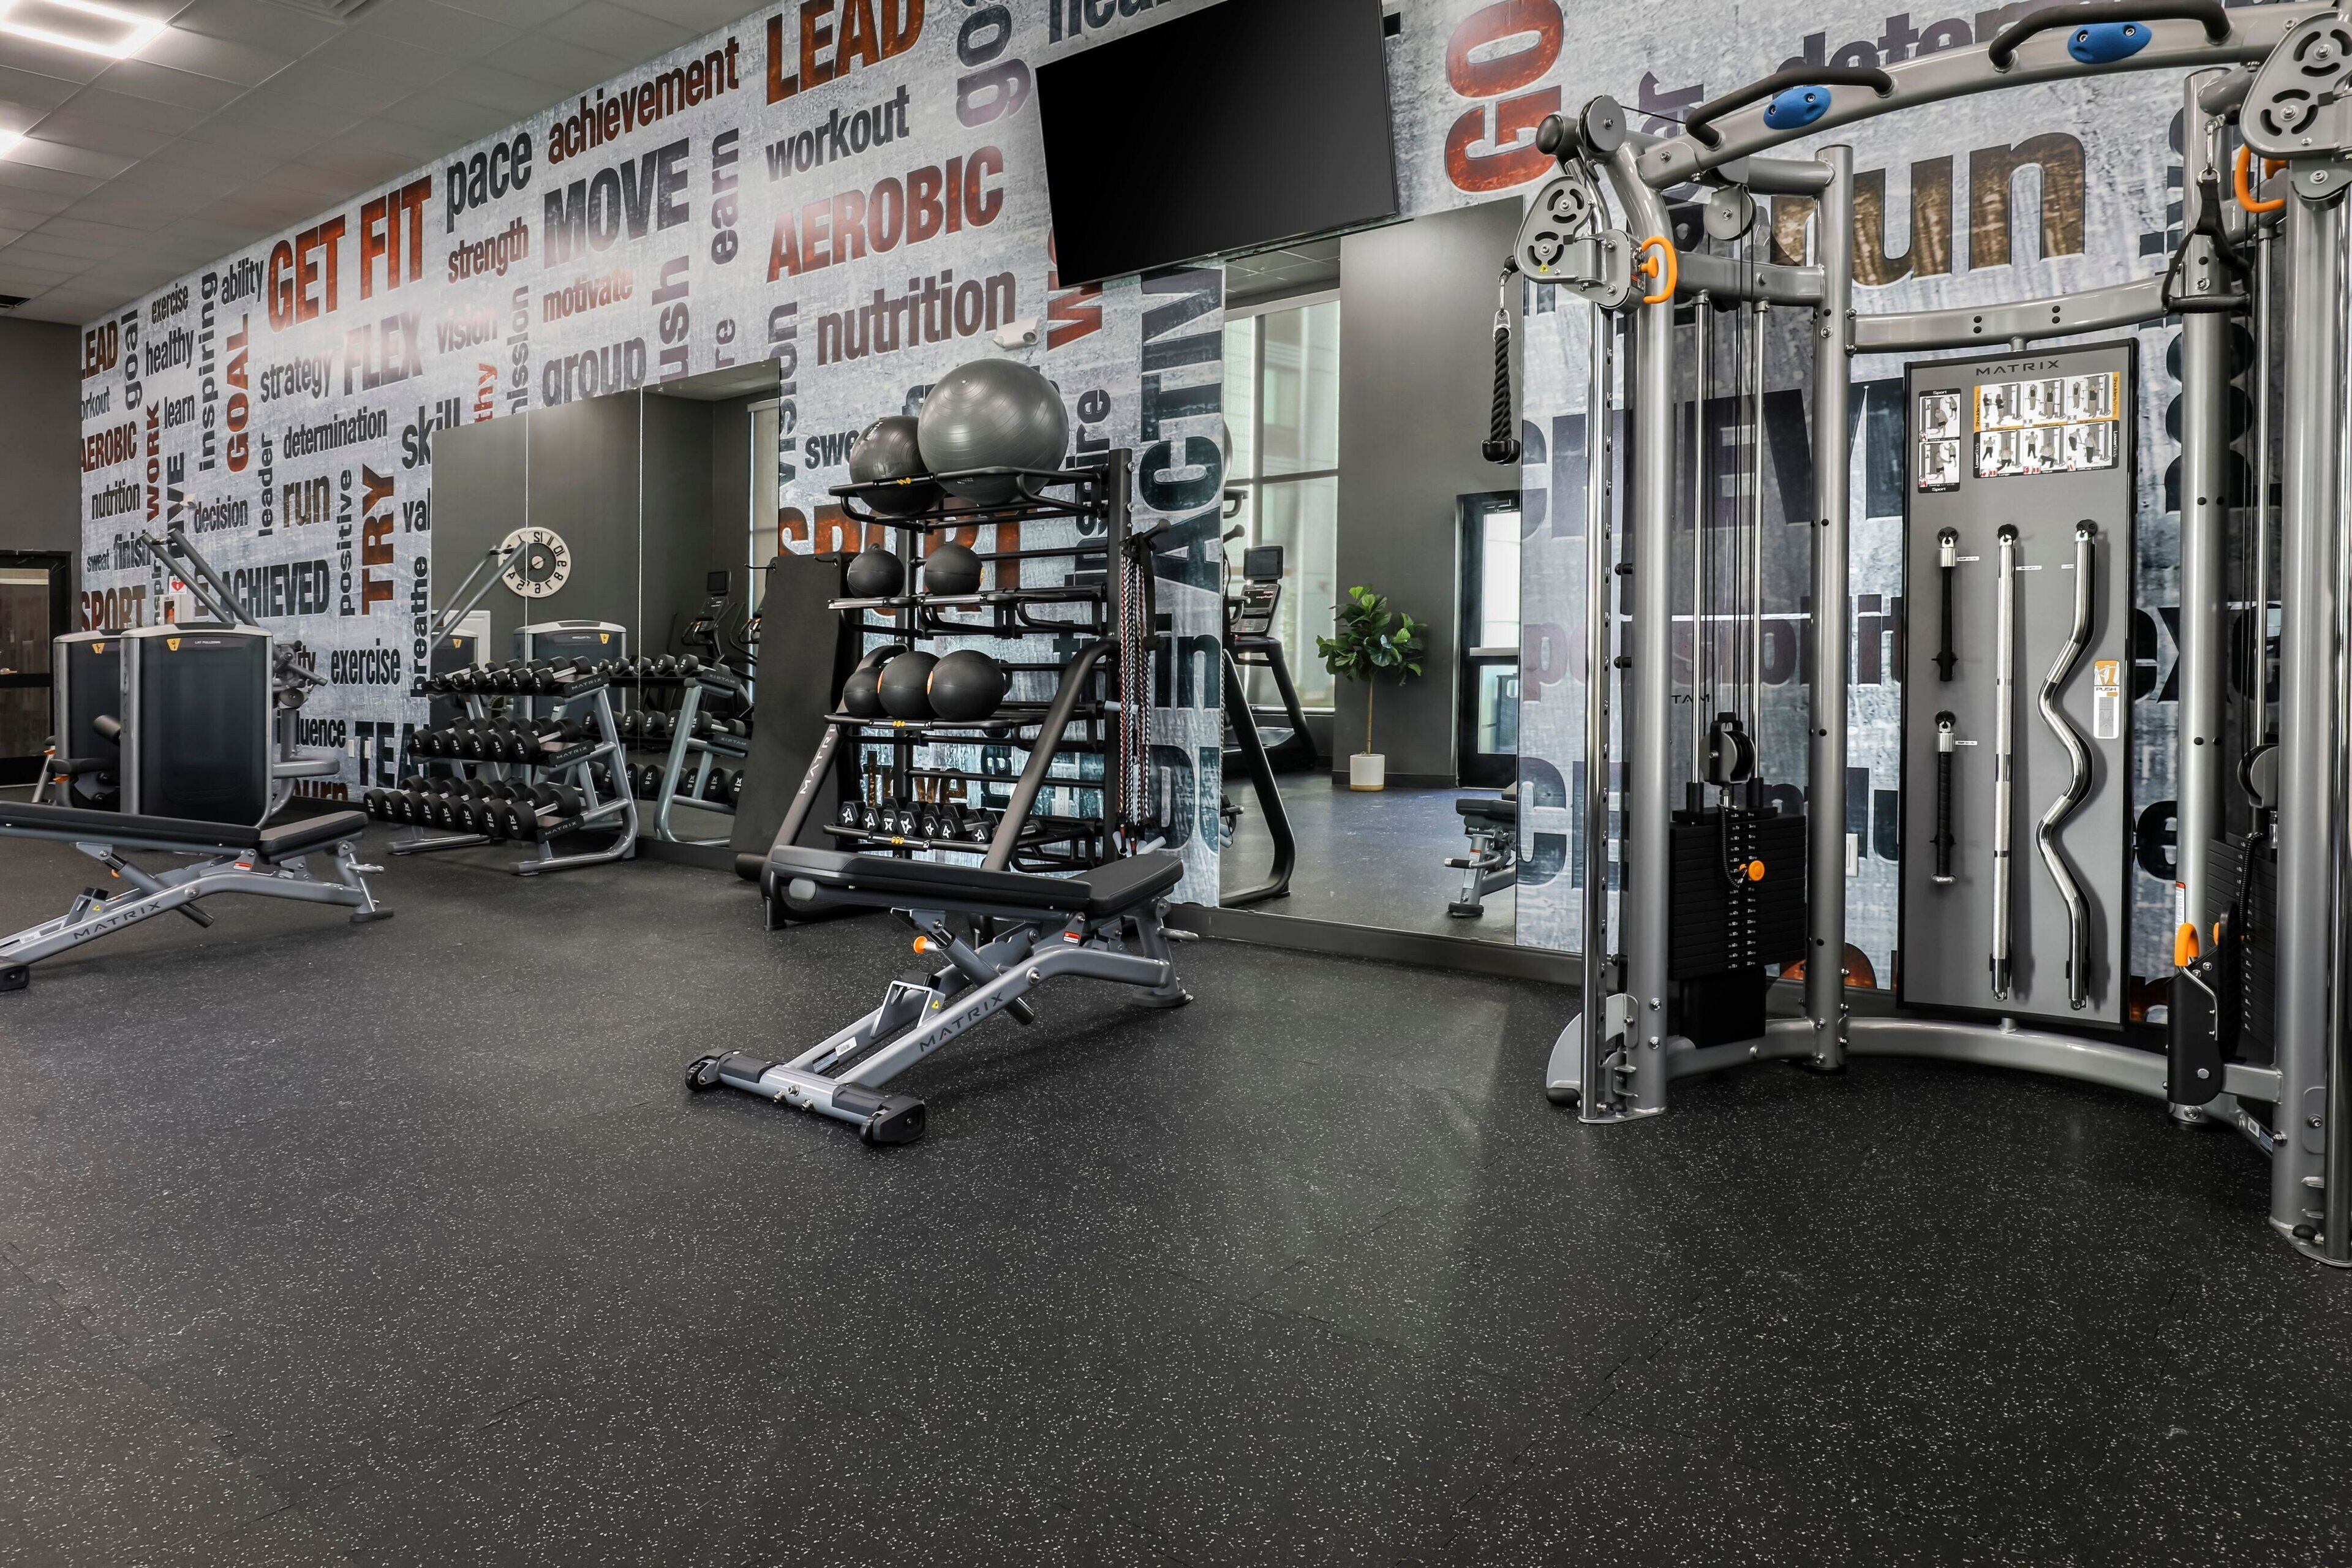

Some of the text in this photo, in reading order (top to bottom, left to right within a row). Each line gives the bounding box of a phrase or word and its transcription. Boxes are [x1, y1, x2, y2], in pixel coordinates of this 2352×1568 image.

[766, 0, 924, 106] LEAD
[549, 36, 739, 164] achievement
[766, 85, 910, 182] workout
[447, 132, 532, 234] pace
[544, 137, 689, 268] MOVE
[711, 128, 739, 265] earn
[766, 146, 1003, 283] AEROBIC
[222, 257, 264, 304] ability
[268, 175, 431, 333] GET FIT
[448, 217, 529, 284] strength
[152, 283, 189, 324] exercise
[543, 268, 633, 323] motivate
[652, 255, 689, 383] ush
[818, 269, 1016, 366] nutrition
[121, 309, 143, 410] goal
[146, 327, 194, 377] healthy
[344, 311, 424, 396] FLEX
[437, 307, 497, 354] vision
[198, 272, 218, 472] inspiring
[227, 313, 248, 472] GOAL
[260, 349, 332, 403] strategy
[542, 337, 646, 407] group
[1976, 360, 2059, 376] MATRIX
[81, 386, 110, 421] orkout
[164, 395, 195, 429] learn
[283, 406, 387, 459] determination
[81, 421, 137, 472] AEROBIC
[147, 400, 159, 522] WORK
[805, 429, 859, 470] swe
[92, 479, 140, 520] nutrition
[194, 495, 247, 533] decision
[258, 432, 273, 537] leader
[283, 475, 330, 527] run
[87, 529, 151, 573] sweat finish
[337, 469, 355, 617] positive
[361, 463, 394, 615] TRY
[81, 584, 146, 631] SPORT
[220, 559, 329, 619] ACHIEVED
[410, 556, 428, 697] breathe
[331, 638, 400, 685] exercise
[571, 677, 601, 690] MATRIX
[355, 721, 429, 789] TEA
[556, 745, 587, 760] MATRIX
[799, 728, 835, 794] MATRI
[545, 821, 577, 836] MATRIX
[74, 900, 162, 941] MATRIX
[919, 992, 1005, 1053] MATRIX
